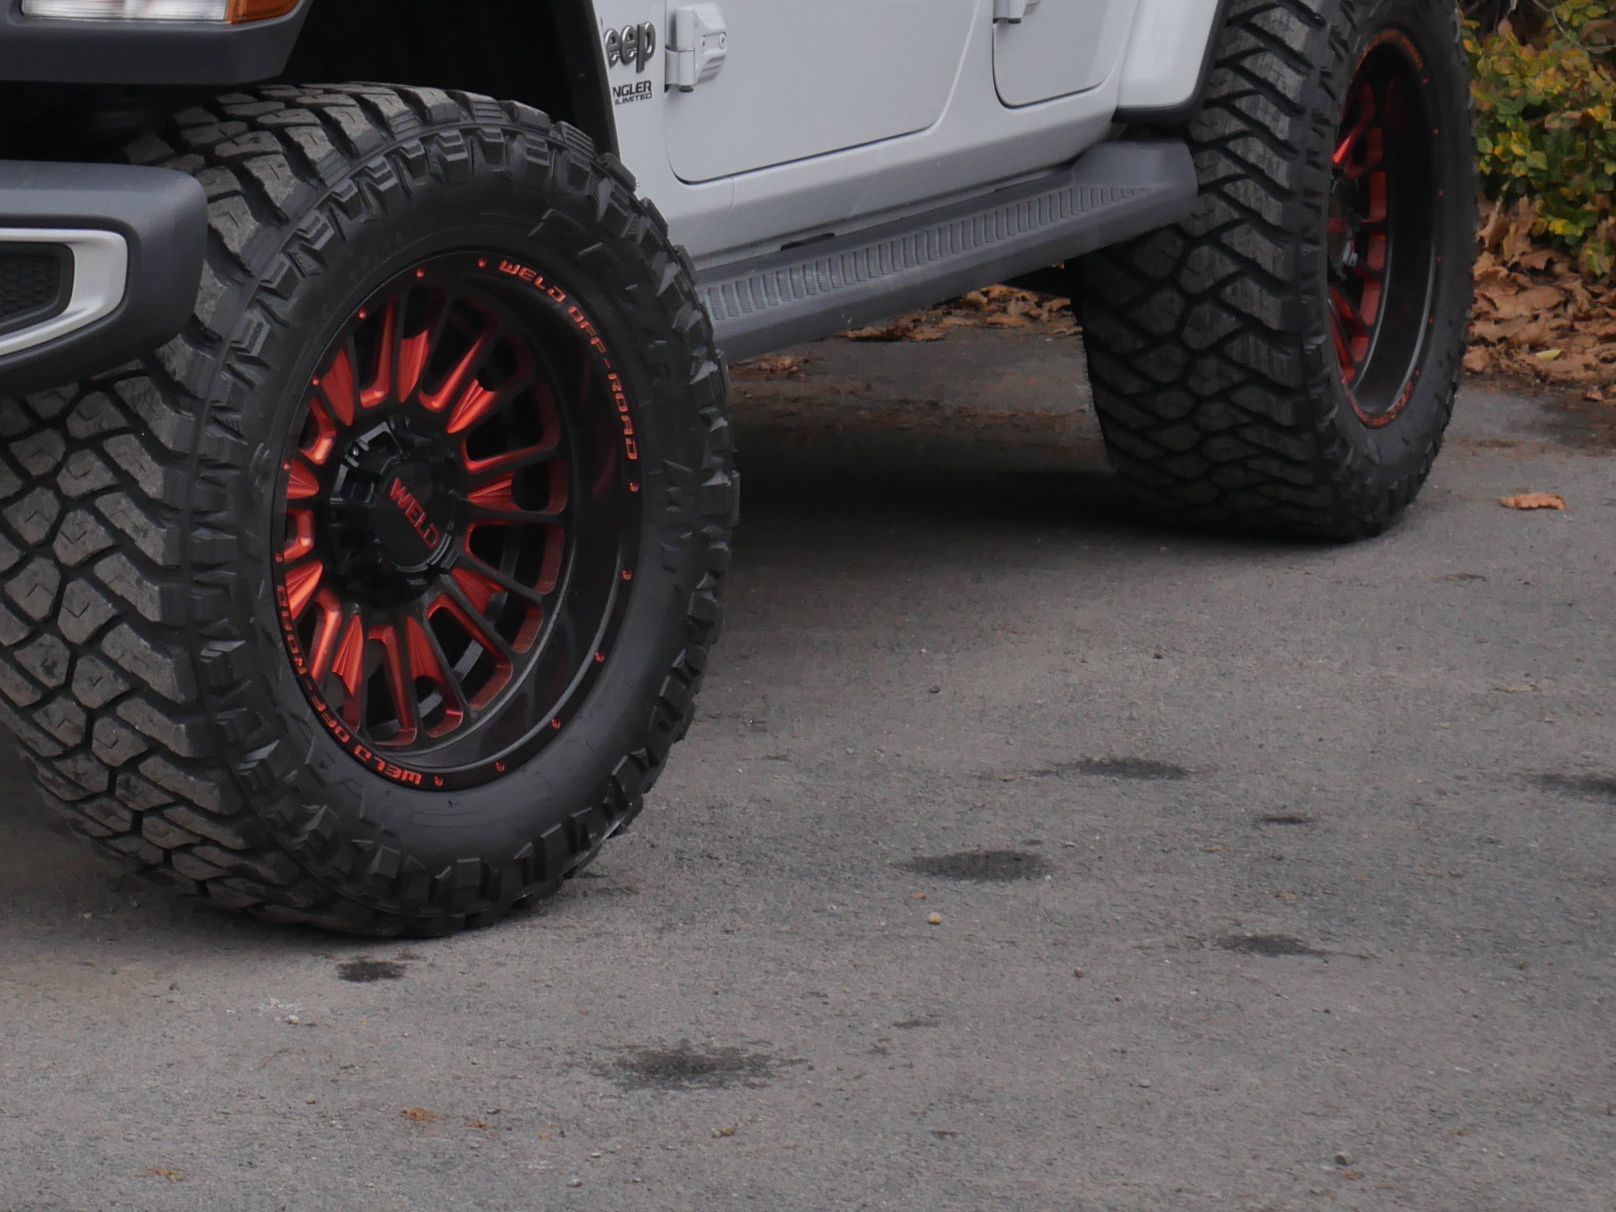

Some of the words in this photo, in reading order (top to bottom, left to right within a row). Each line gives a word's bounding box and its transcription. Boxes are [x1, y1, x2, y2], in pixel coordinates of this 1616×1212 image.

[602, 20, 657, 75] eep
[612, 79, 653, 98] NGLER
[498, 259, 567, 303] WELD
[567, 305, 638, 460] OFF-ROAD
[389, 477, 441, 549] WELD
[352, 744, 423, 785] WELD
